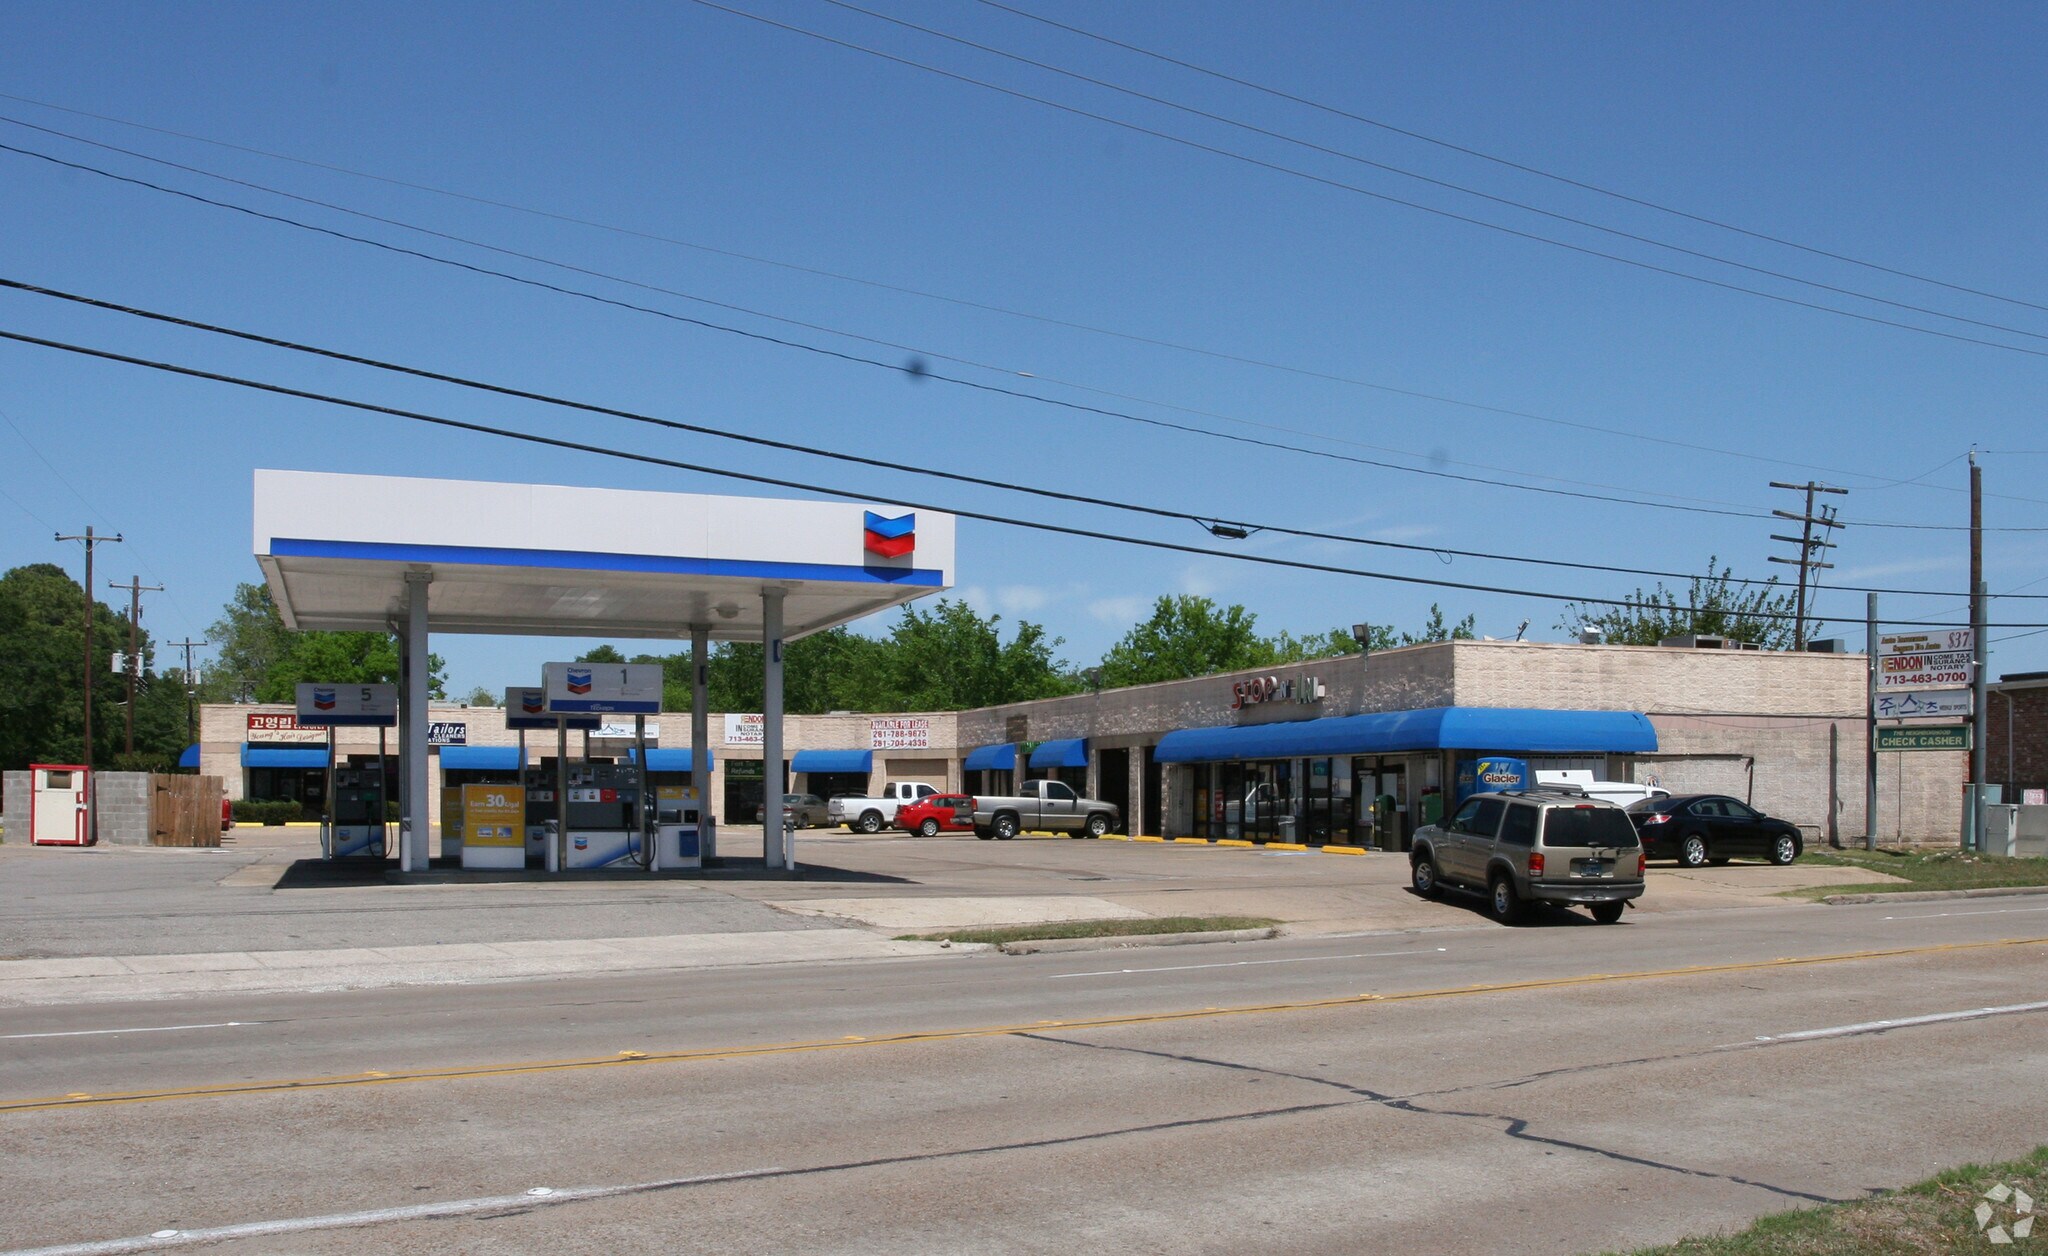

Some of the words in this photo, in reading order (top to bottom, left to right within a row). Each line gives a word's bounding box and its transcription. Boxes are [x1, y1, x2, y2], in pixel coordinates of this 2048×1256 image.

[1947, 631, 1970, 649] $37
[620, 668, 627, 685] 1
[1884, 672, 1967, 685] 713-463-0700
[361, 688, 371, 701] 5
[1231, 676, 1275, 711] STOP
[428, 723, 466, 734] Tailors
[873, 739, 926, 747] 281-704-4336
[1881, 737, 1916, 746] CHECK
[1919, 736, 1962, 746] CASHER
[1483, 773, 1520, 783] Glacier
